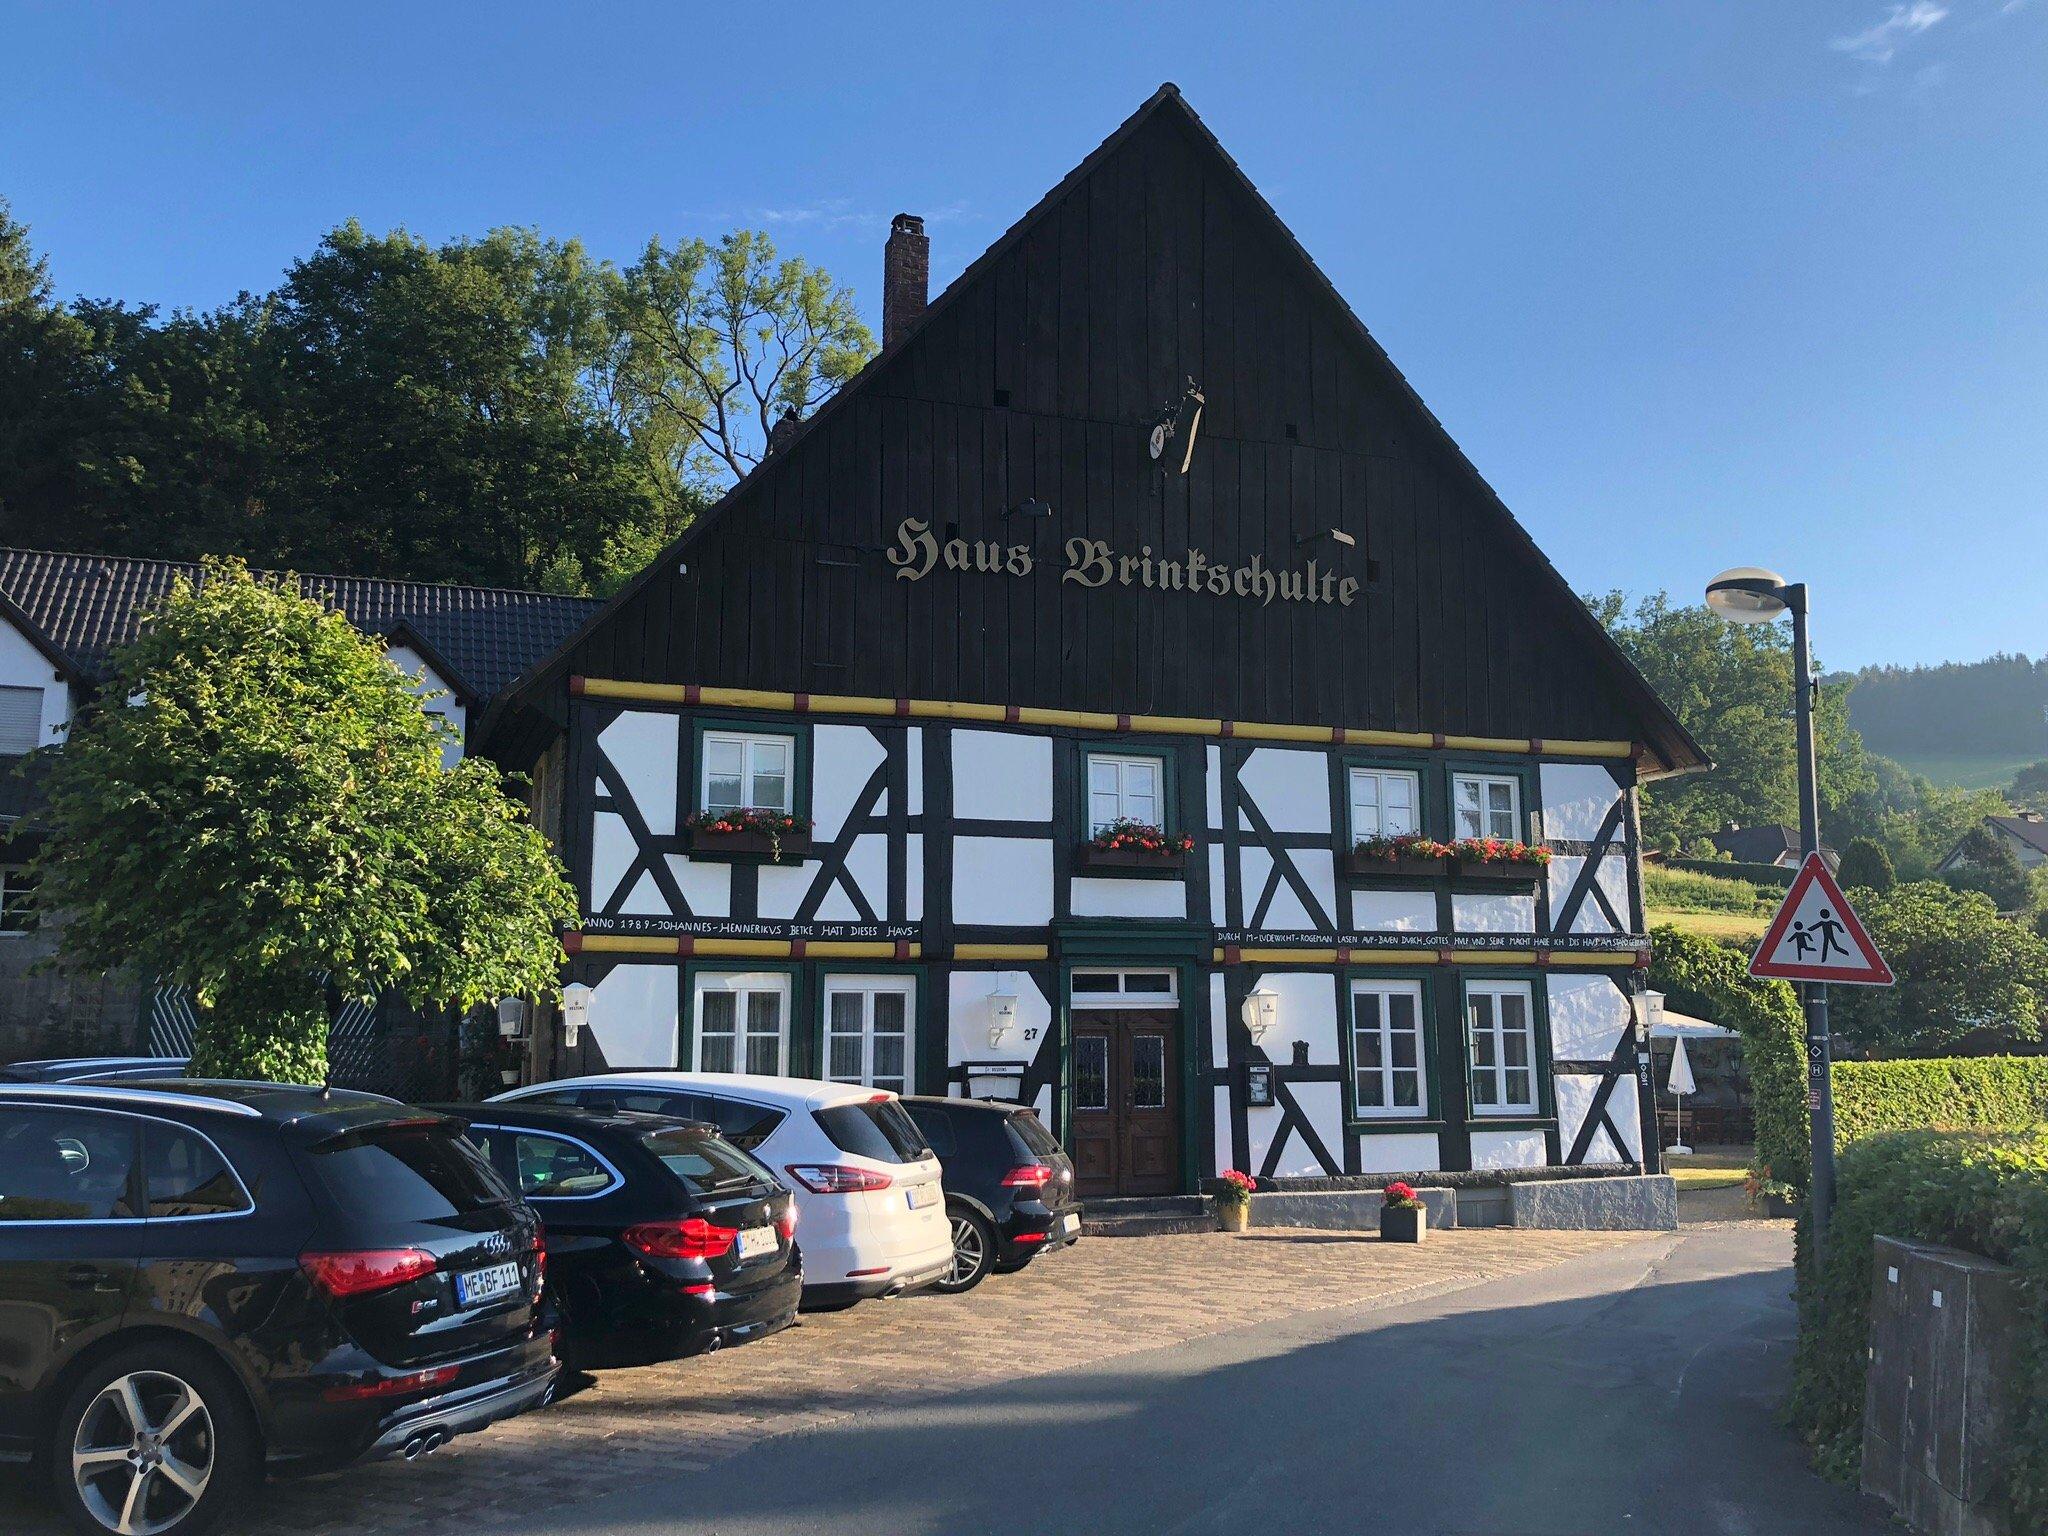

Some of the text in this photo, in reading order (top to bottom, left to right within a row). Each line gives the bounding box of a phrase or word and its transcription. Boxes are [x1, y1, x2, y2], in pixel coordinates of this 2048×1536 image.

[886, 517, 1360, 607] Haus Brinkschulte
[584, 917, 615, 929] ANNO
[850, 926, 877, 936] DIESES
[1024, 1028, 1038, 1040] 27
[464, 1274, 481, 1297] ME
[485, 1269, 498, 1292] BF
[499, 1265, 519, 1288] 111
